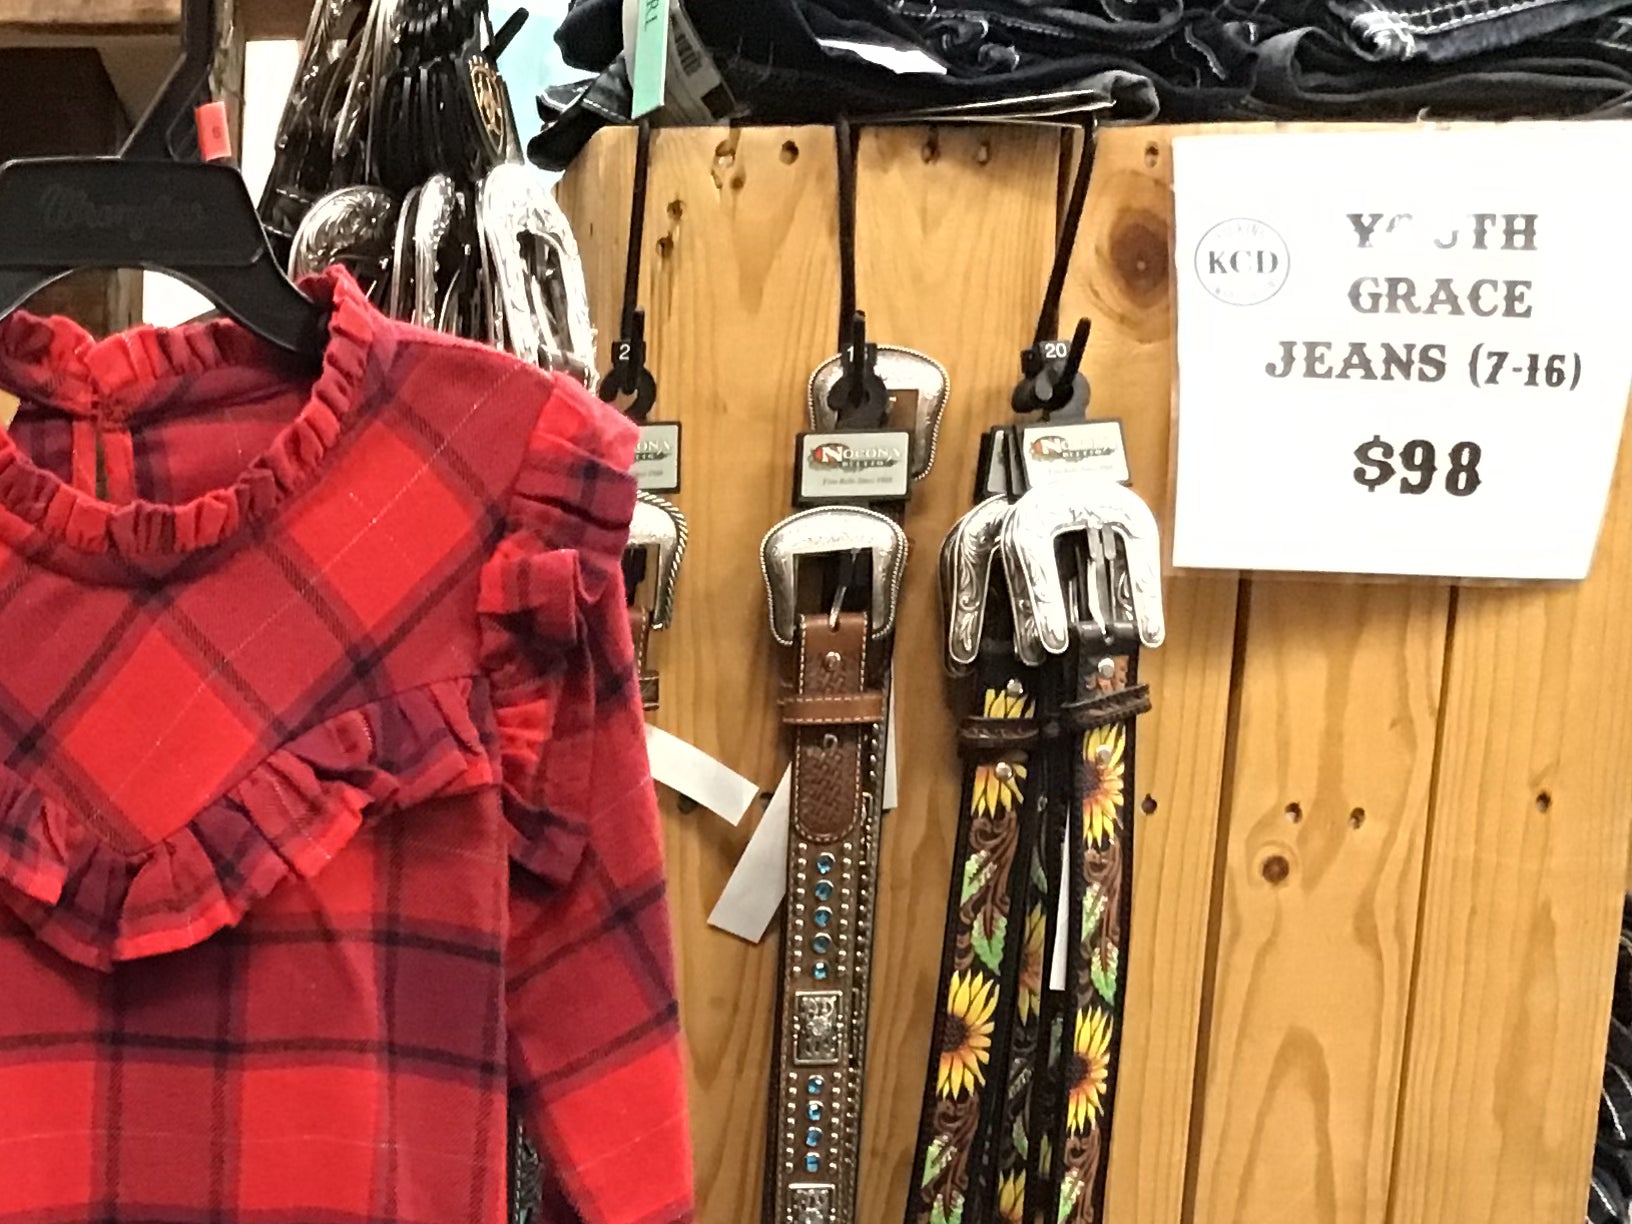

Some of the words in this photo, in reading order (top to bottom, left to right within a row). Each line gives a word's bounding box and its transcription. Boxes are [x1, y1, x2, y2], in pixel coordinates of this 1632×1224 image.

[1209, 250, 1278, 274] KCD
[1348, 278, 1532, 318] GRACE
[1044, 342, 1067, 359] 20
[1266, 341, 1446, 382] JEANS
[1469, 343, 1581, 391] (7-16)
[1353, 435, 1482, 496] $98
